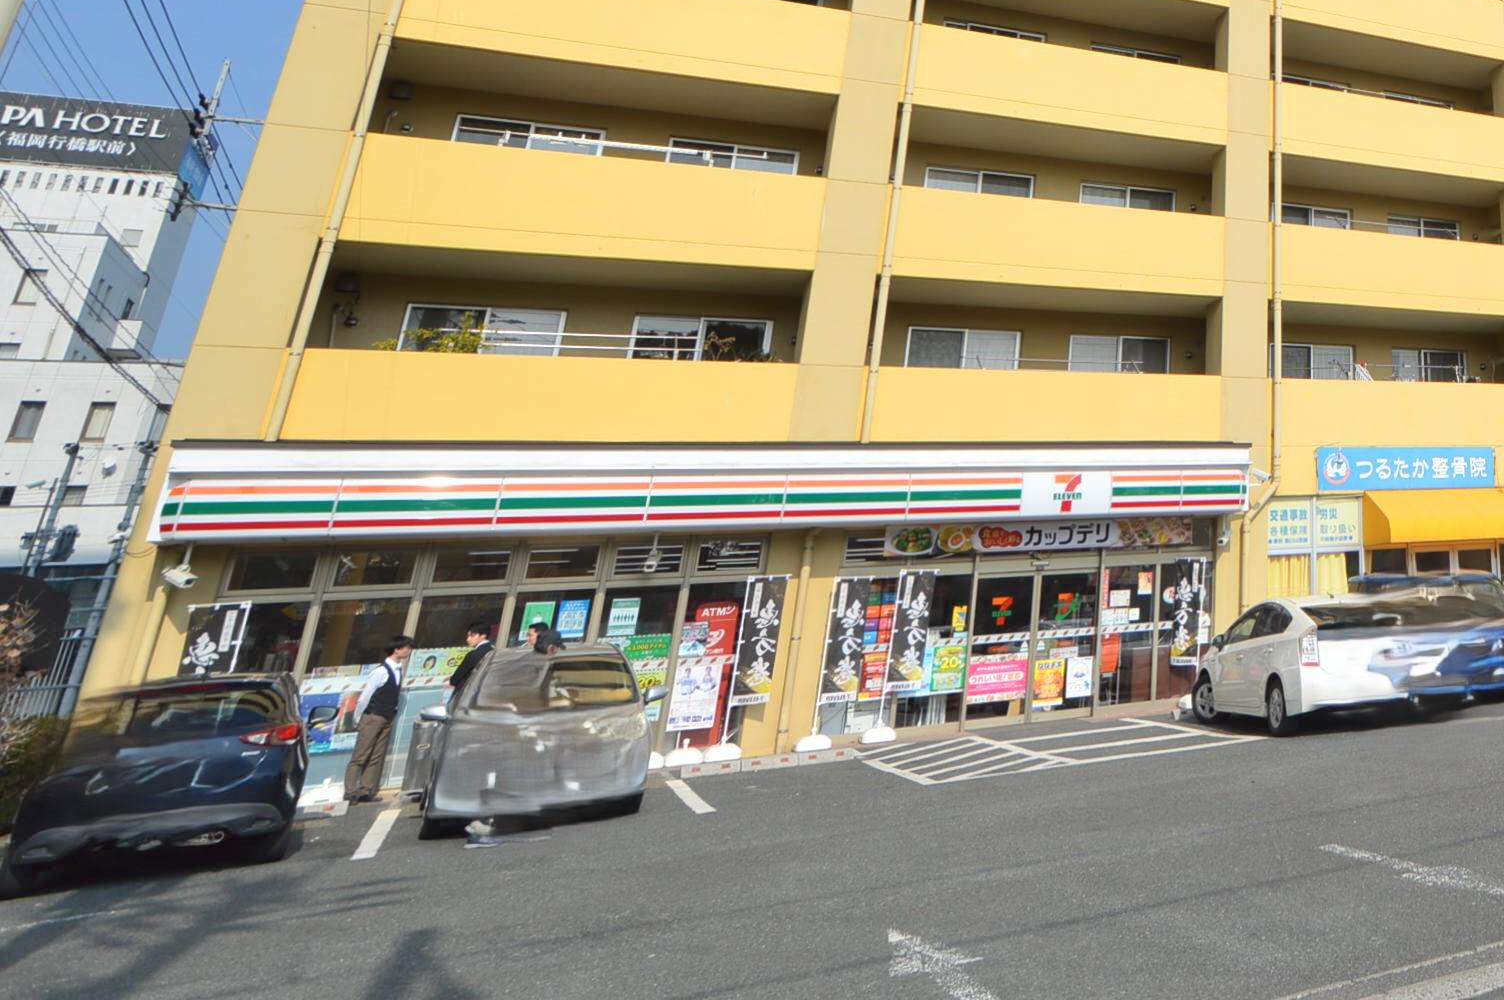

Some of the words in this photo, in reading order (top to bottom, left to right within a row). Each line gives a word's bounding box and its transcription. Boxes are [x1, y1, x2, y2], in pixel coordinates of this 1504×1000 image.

[52, 110, 167, 139] HOTEL
[1356, 456, 1488, 480] つるたか整骨院
[1024, 523, 1110, 546] カップデリ
[702, 606, 726, 617] ATM
